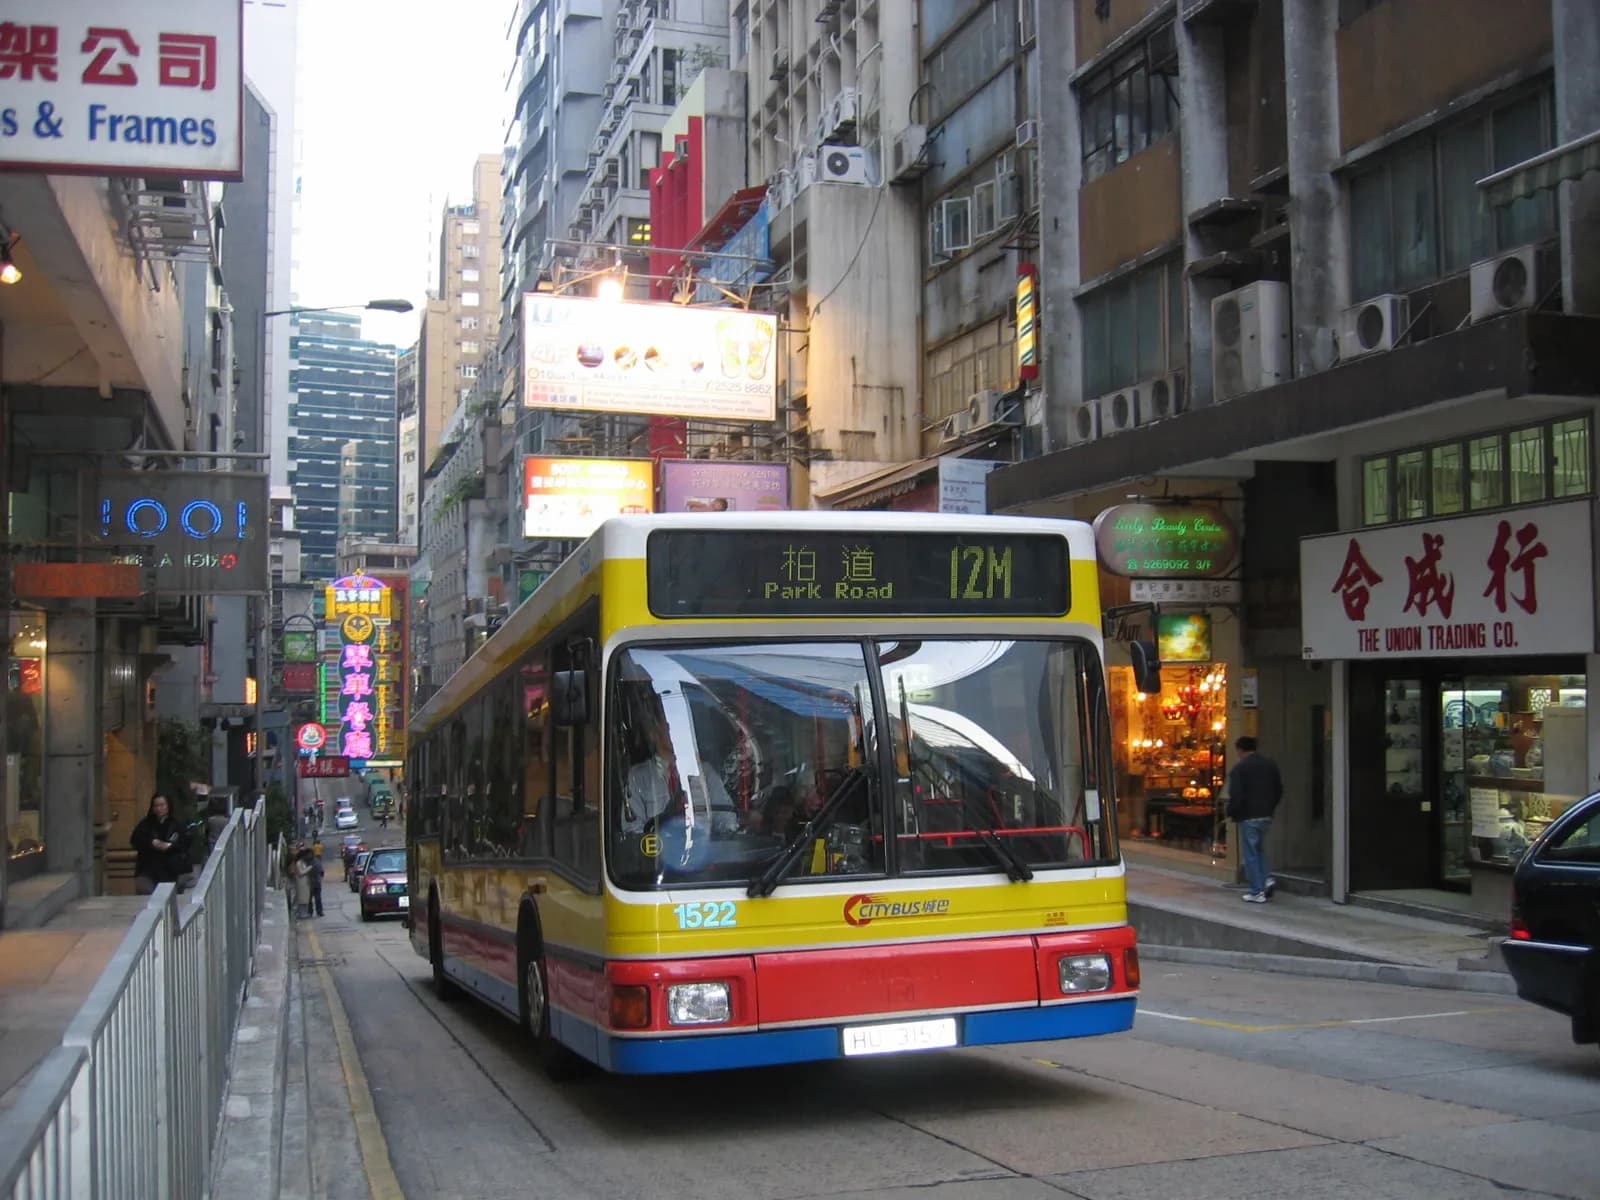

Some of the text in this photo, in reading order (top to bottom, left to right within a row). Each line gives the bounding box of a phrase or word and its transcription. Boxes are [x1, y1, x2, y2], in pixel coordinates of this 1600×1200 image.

[0, 22, 216, 90] 架公司
[33, 101, 63, 138] &
[89, 104, 216, 147] Frames
[781, 544, 877, 582] 柏道
[950, 545, 1012, 600] 12M
[764, 582, 893, 599] Park Road
[1357, 621, 1519, 653] THE UNION TRADING CO.
[673, 902, 738, 929] 1522
[859, 901, 921, 918] CITYBUS
